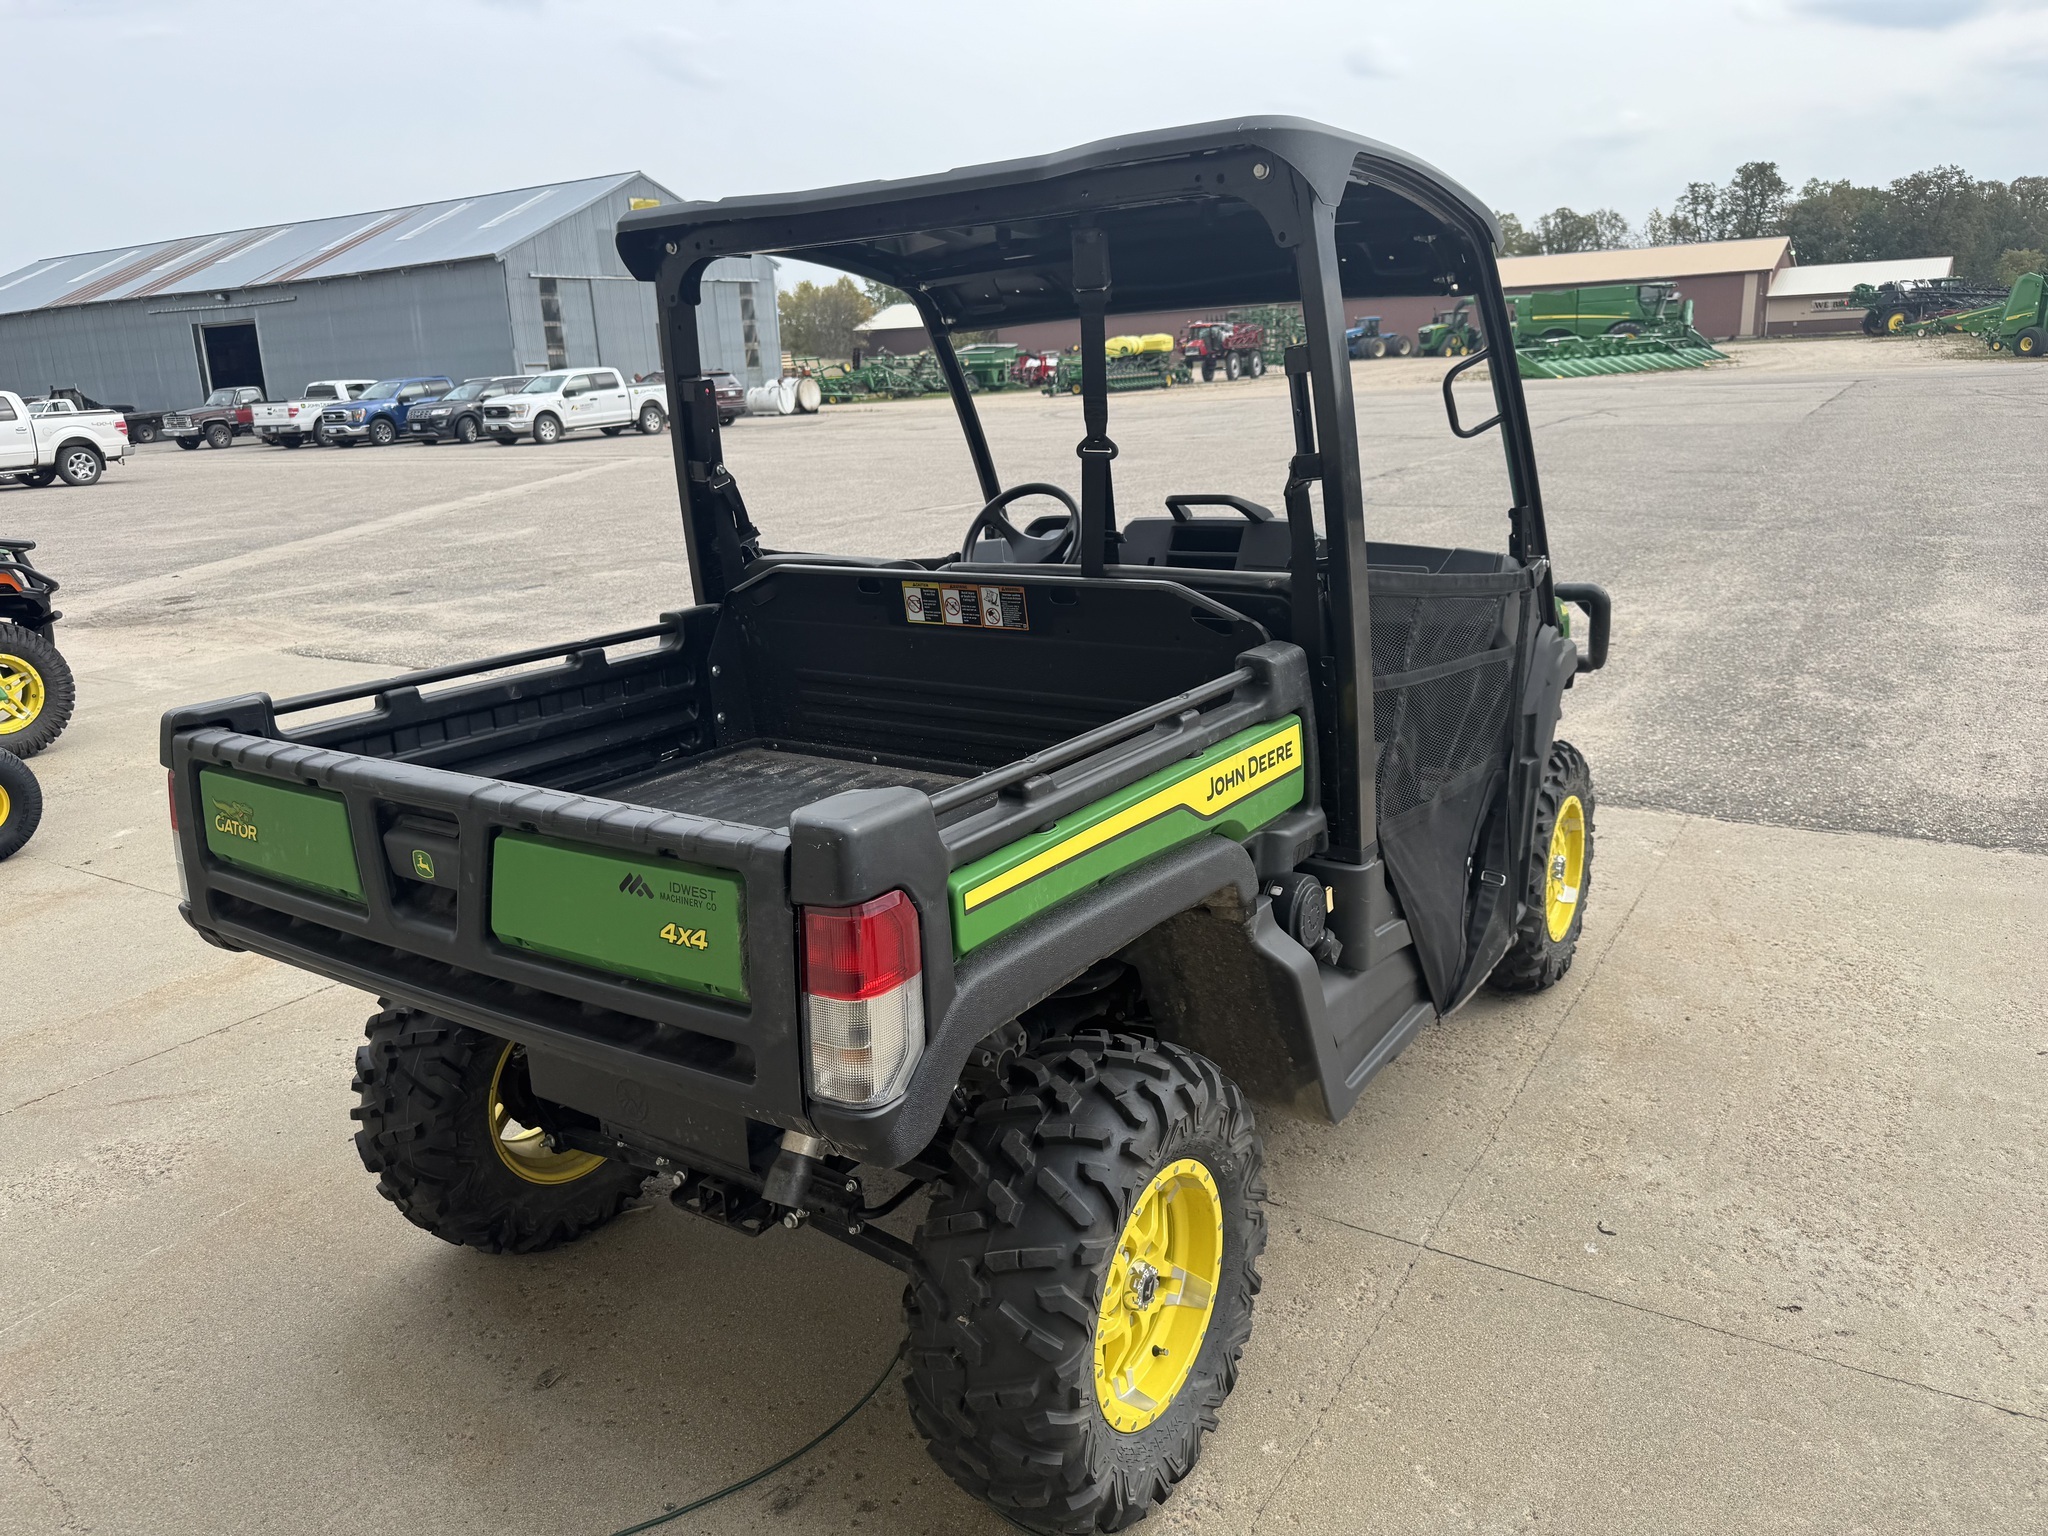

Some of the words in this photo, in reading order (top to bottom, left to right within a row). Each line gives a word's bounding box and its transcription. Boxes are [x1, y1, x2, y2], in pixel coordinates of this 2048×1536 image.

[1206, 765, 1246, 802] JOHN
[1248, 740, 1293, 779] DEERE
[215, 814, 257, 842] GATOR
[660, 892, 703, 909] MACHINERY
[706, 902, 717, 912] CO
